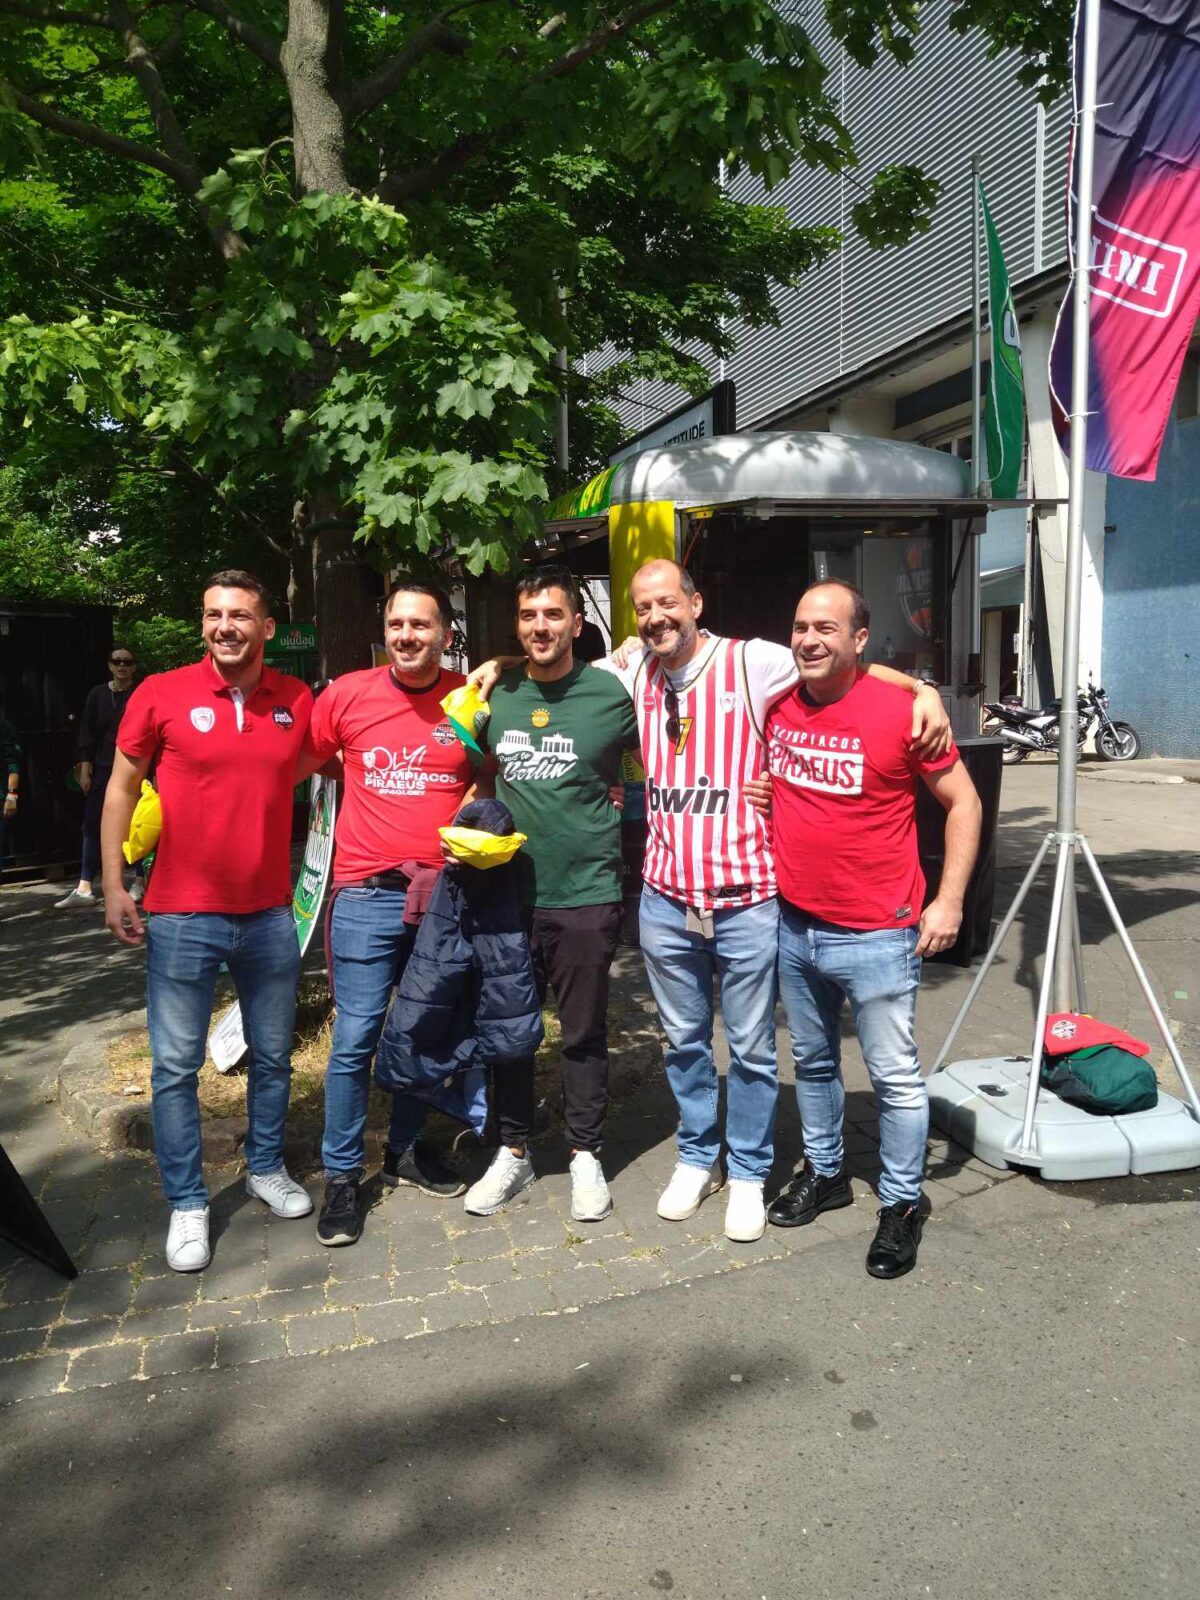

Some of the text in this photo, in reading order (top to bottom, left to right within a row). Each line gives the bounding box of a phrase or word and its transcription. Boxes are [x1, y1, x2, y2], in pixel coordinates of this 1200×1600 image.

[675, 717, 694, 755] 7
[364, 770, 457, 784] OLYMPIACOS
[504, 757, 577, 782] Berlin
[364, 778, 426, 791] PIRAEUS
[648, 776, 730, 815] bwin
